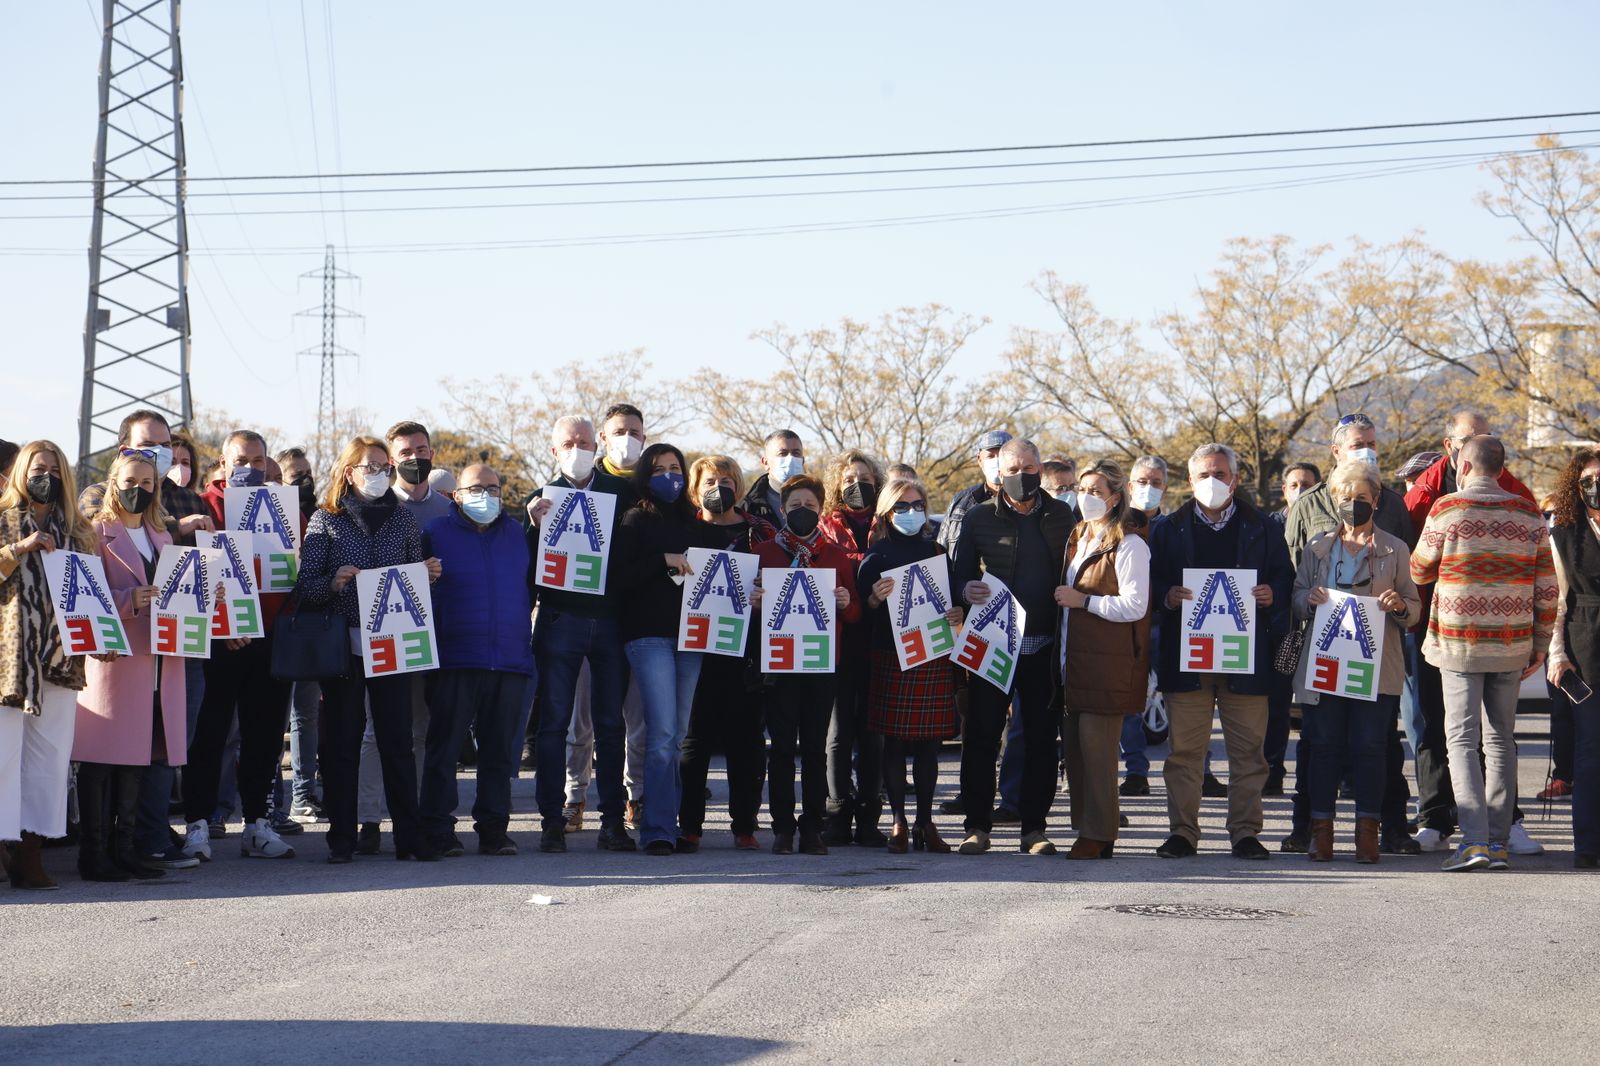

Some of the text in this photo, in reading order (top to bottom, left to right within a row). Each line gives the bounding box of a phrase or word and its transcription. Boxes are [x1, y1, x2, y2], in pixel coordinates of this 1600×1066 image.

[238, 491, 256, 530] TAFORMA
[271, 493, 296, 542] CIUDADANA
[544, 492, 574, 542] PLATAFORMA
[587, 497, 605, 546] CIUDADANA
[60, 554, 72, 609] PLATAFORMA
[81, 560, 112, 609] CIUDADANA
[155, 550, 189, 606] PLATAFORMA
[200, 554, 210, 607] CIUDADANA
[228, 537, 253, 588] CIUDADANA
[687, 553, 717, 606] PLATAFORMA
[730, 558, 748, 609] CIUDADANA
[921, 565, 947, 607] CIUDADANA
[366, 571, 387, 630] PLATAFORMA
[401, 571, 427, 620] CIUDADANA
[767, 572, 794, 628] PLATAFORMA
[807, 574, 830, 624] CIUDADANA
[896, 569, 910, 626] PLATAFORMA
[971, 588, 1007, 626] PLATAFORMA
[1187, 573, 1215, 627] PLATAFORMA
[1228, 576, 1250, 625] CIUDADANA
[1358, 602, 1377, 654] CIUDADANA
